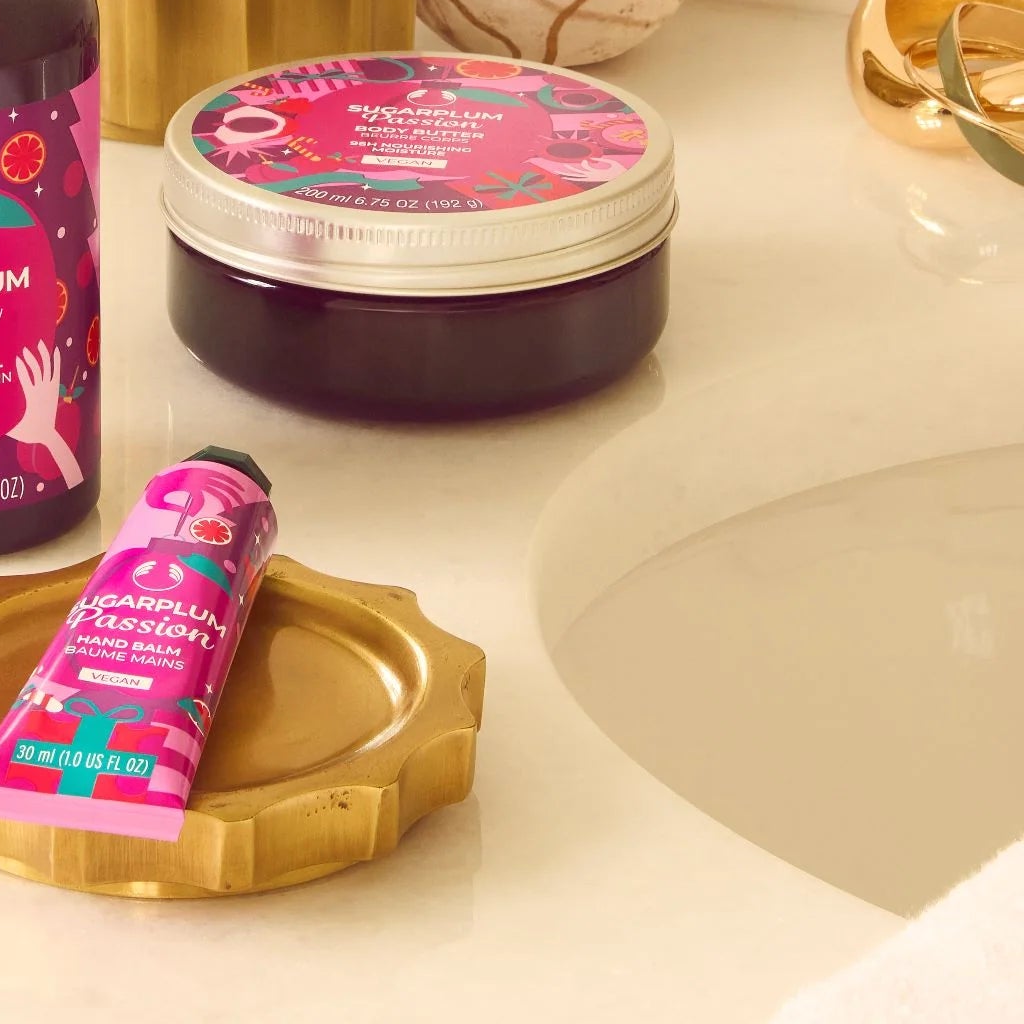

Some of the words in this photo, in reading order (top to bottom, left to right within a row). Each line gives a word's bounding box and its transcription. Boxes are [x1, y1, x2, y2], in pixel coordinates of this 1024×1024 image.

[347, 104, 503, 121] SUGARPLUM
[362, 112, 483, 129] Passion
[355, 126, 409, 134] BODY
[413, 129, 484, 139] BUTTER
[421, 136, 469, 144] CORPS
[372, 147, 446, 156] MOISTURE
[381, 143, 471, 152] NOURISHING
[377, 158, 432, 166] VEGAN
[294, 187, 328, 198] 200
[330, 194, 352, 203] ml
[355, 196, 389, 207] 6.75
[396, 200, 418, 208] OZ
[426, 200, 462, 210] (192
[466, 200, 482, 209] g)
[0, 476, 24, 500] OZ)
[66, 607, 215, 650] Passion
[77, 635, 128, 648] HAND
[132, 642, 181, 656] BALM
[64, 645, 127, 661] BAUME
[131, 654, 184, 670] MAINS
[91, 672, 140, 686] VEGAN
[17, 745, 34, 760] 30
[38, 748, 56, 763] ml
[59, 750, 82, 767] (1.0
[86, 753, 104, 769] US
[106, 755, 120, 770] FL
[126, 758, 149, 775] OZ)
